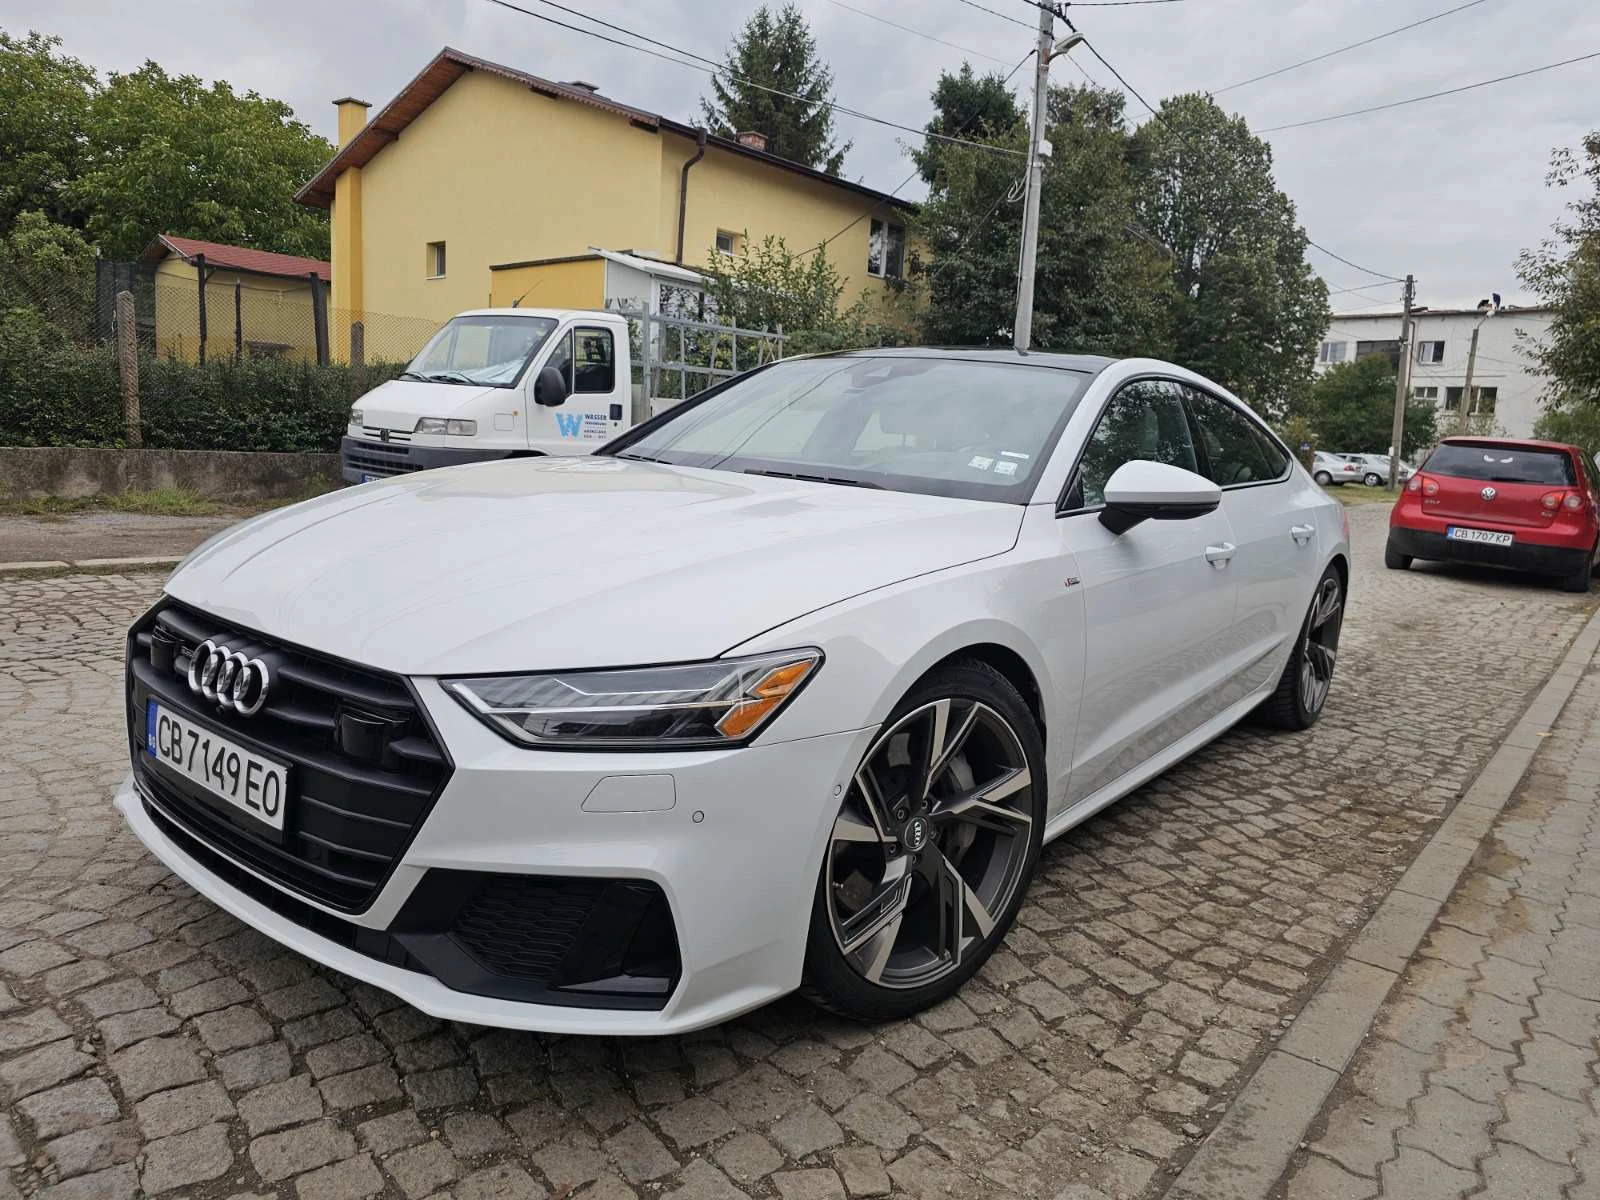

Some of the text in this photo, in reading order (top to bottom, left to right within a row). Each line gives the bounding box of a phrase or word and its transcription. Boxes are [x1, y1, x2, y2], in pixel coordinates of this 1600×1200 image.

[1455, 530, 1510, 543] CB 1707 KP
